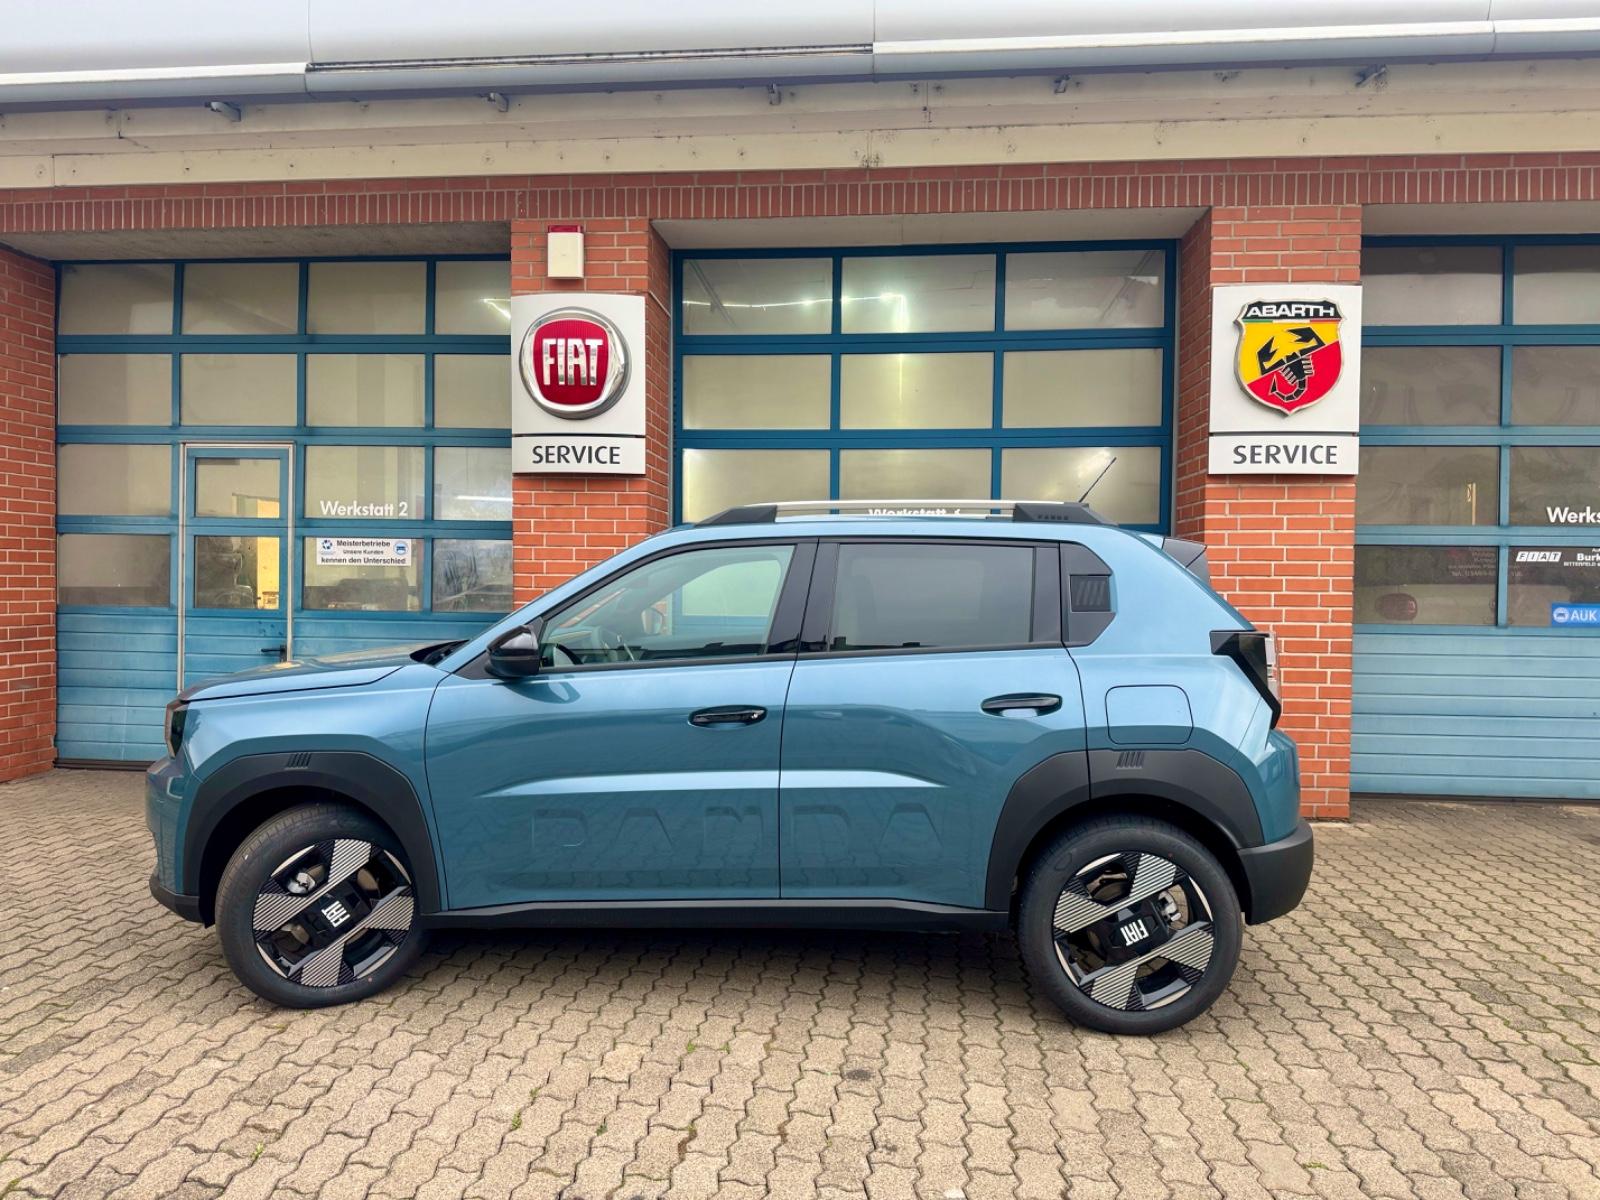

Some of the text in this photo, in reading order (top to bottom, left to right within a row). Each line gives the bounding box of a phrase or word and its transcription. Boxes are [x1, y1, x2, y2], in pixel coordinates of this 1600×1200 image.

[1247, 304, 1335, 317] ABARTH
[542, 338, 604, 386] FIAT
[532, 445, 621, 465] SERVICE
[1233, 445, 1338, 465] SERVICE
[320, 500, 408, 517] Werkstatt 2
[336, 540, 391, 548] Meisterbetriebe
[1516, 551, 1562, 562] FIAT
[1570, 608, 1597, 621] AUK
[321, 900, 351, 928] FIAT
[1120, 918, 1149, 947] FIAT
